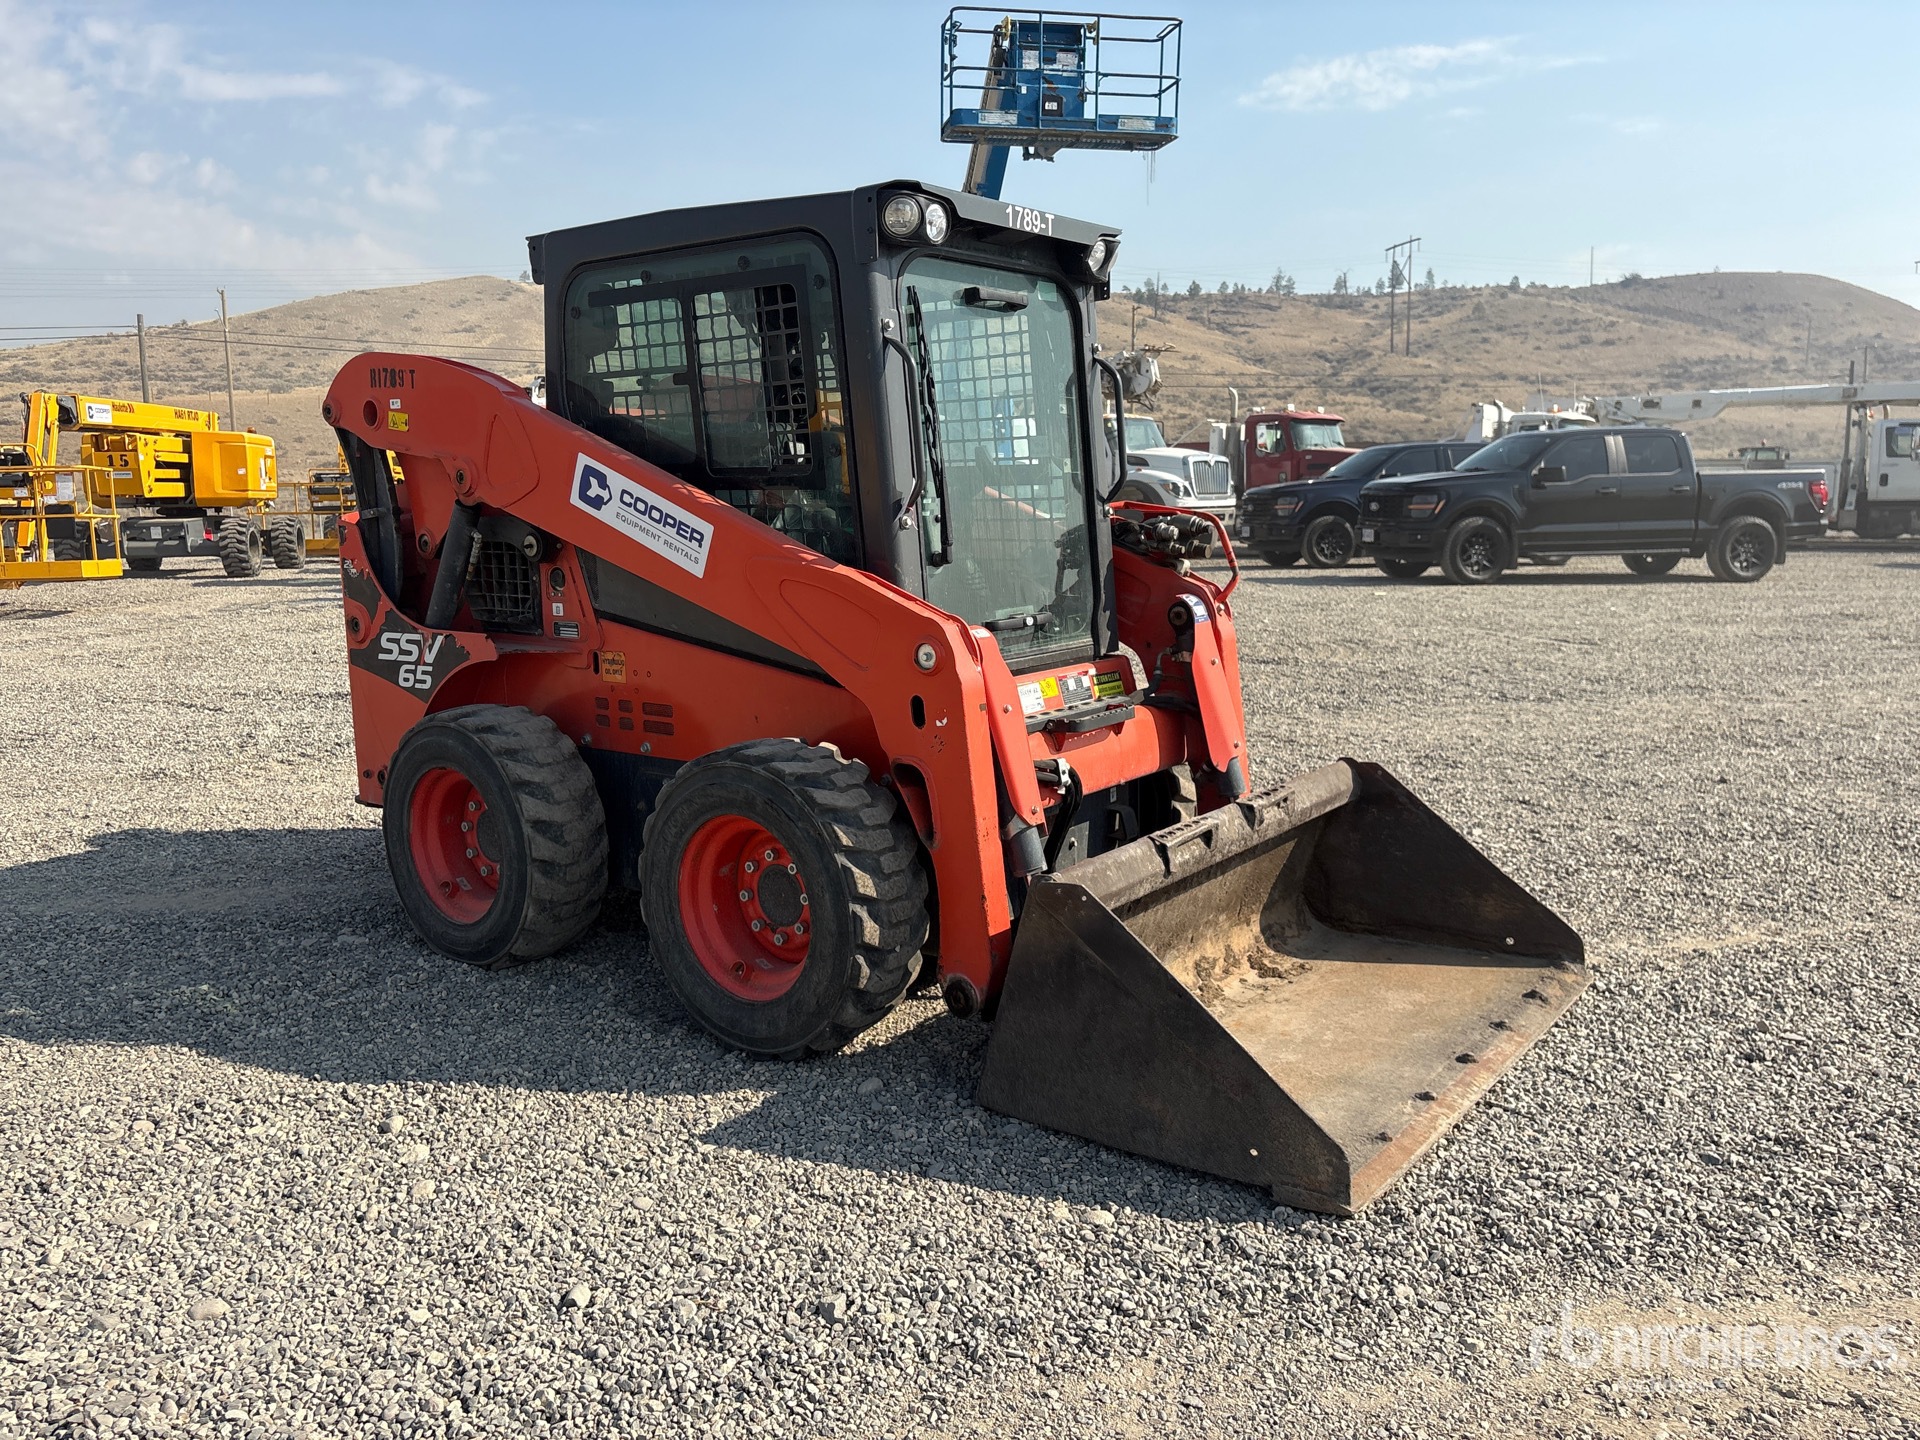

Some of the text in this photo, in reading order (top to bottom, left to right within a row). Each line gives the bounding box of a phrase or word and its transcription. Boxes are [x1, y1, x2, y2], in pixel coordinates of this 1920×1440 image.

[1006, 204, 1055, 236] 1789-T
[107, 454, 130, 467] 15
[620, 489, 705, 548] COOPER
[615, 511, 699, 565] EQUIPMENT RENTALS
[378, 632, 444, 663] SSV
[398, 664, 433, 690] 65
